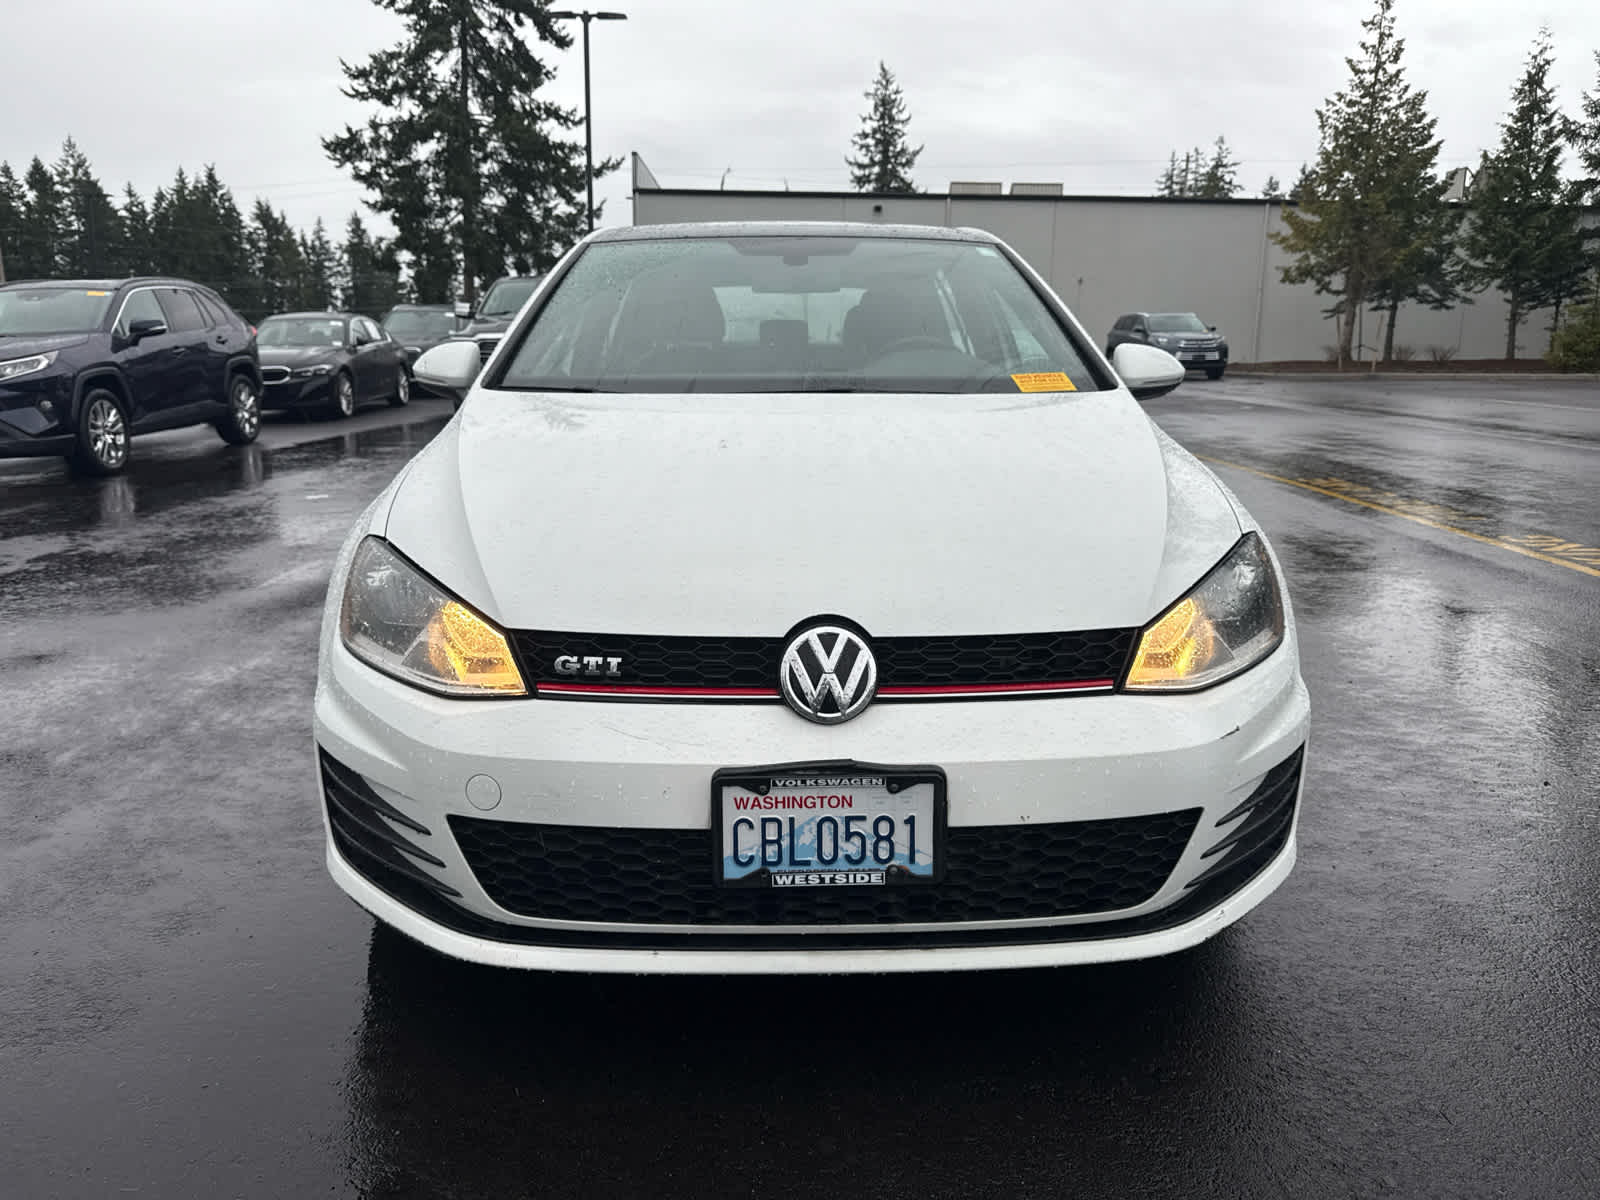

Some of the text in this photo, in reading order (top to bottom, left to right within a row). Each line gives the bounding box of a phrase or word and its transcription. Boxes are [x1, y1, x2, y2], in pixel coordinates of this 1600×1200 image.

[554, 655, 622, 676] GTI
[776, 778, 882, 786] VOLKSWAGEN
[734, 795, 853, 810] WASHINGTON
[733, 815, 916, 867] CBL0581
[776, 873, 882, 885] WESTSIDE
